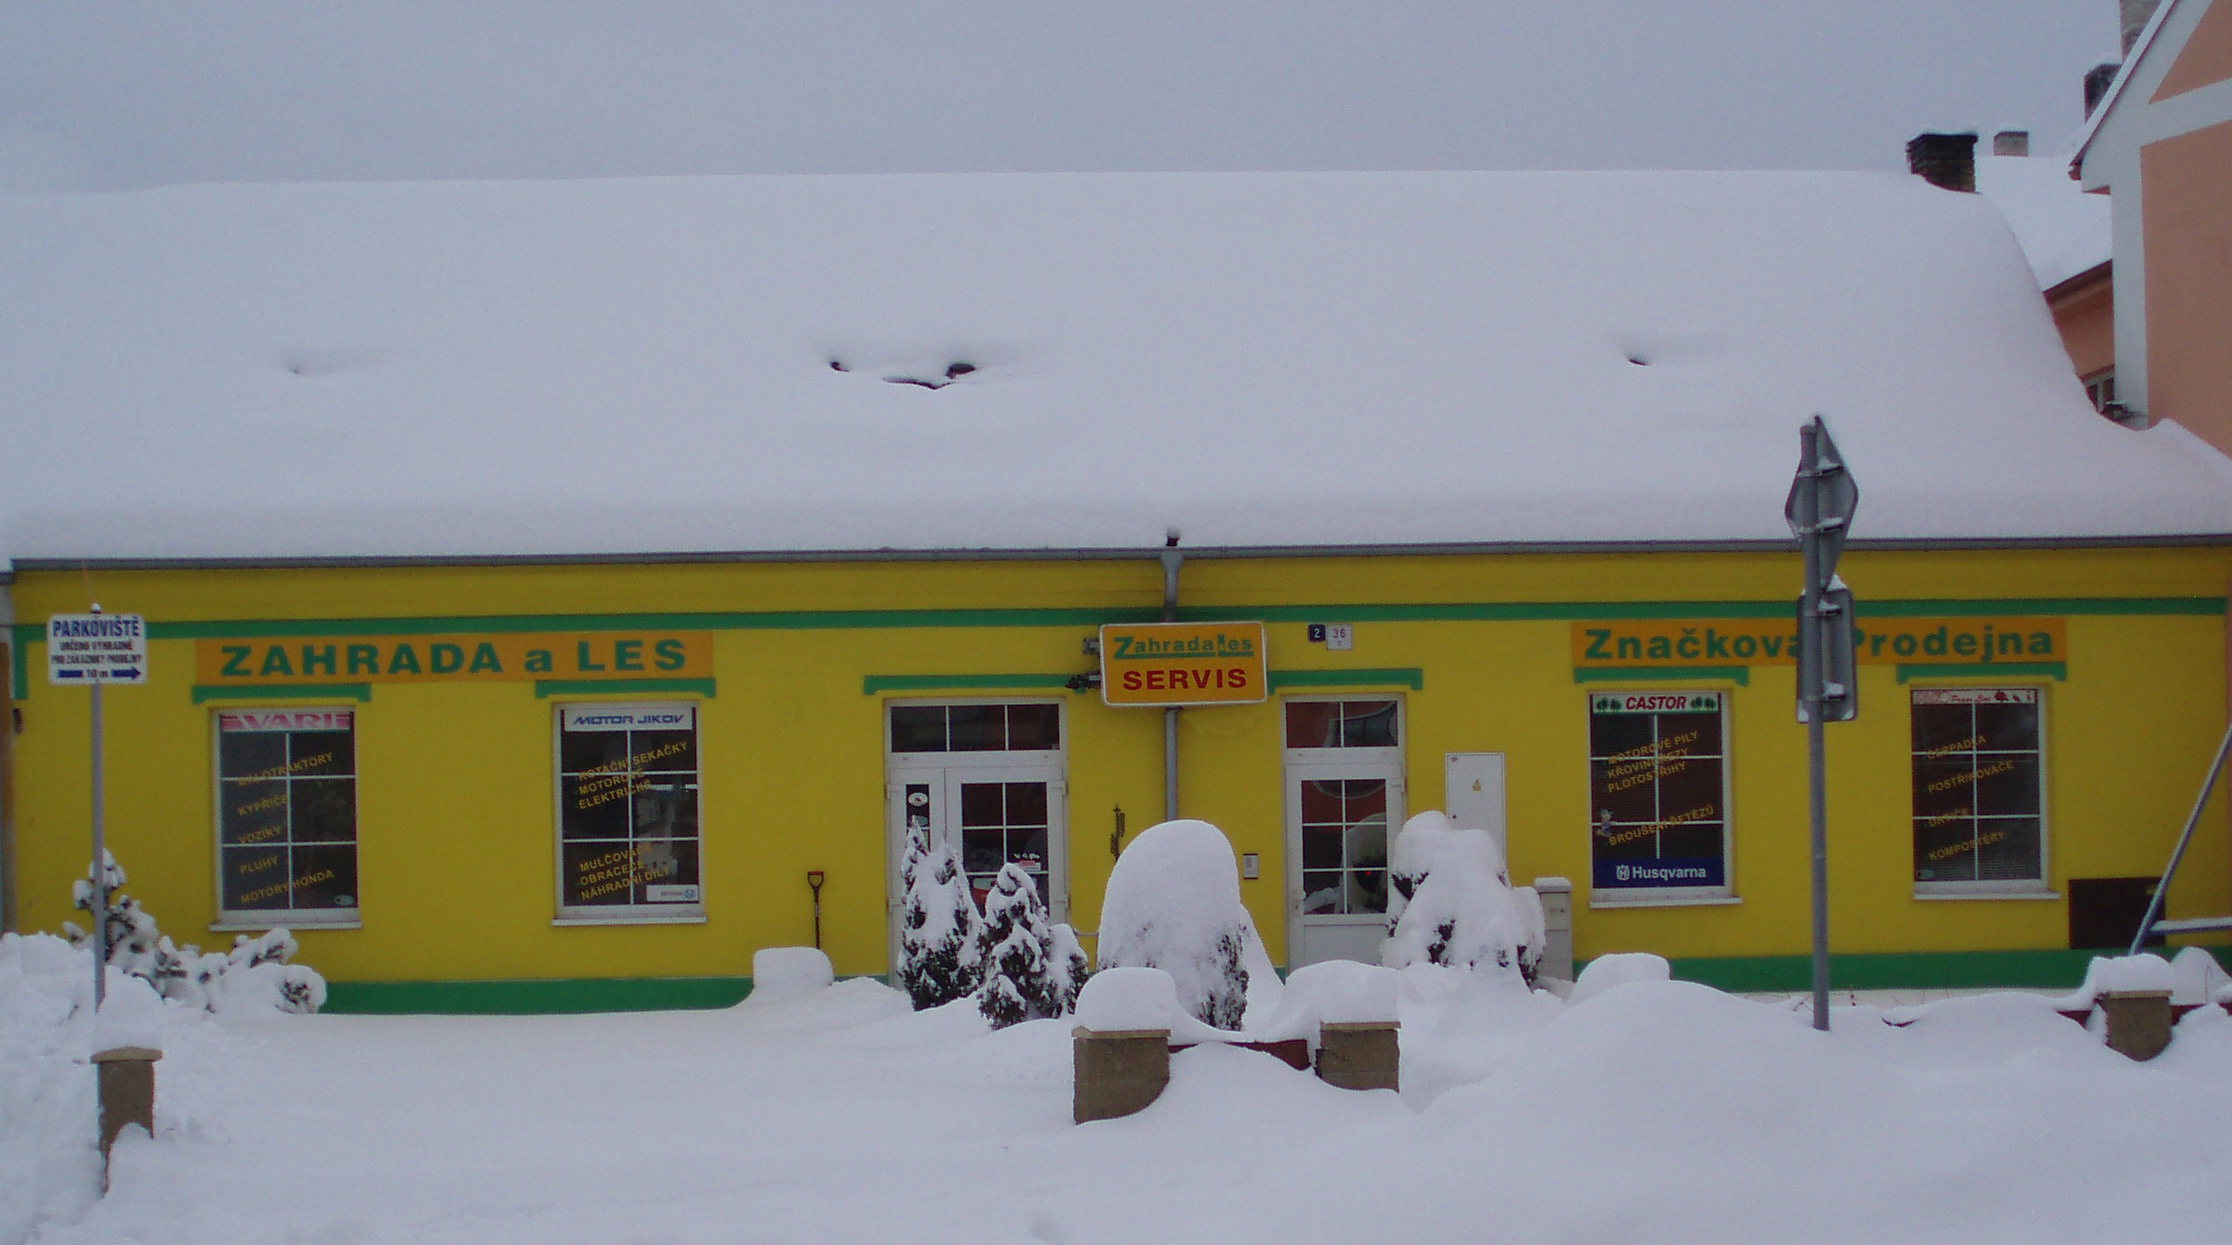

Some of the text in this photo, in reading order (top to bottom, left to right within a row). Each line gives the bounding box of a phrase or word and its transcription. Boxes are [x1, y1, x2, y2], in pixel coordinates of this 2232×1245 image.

[52, 615, 139, 637] PARKOVIŠTĚ
[1314, 628, 1320, 638] 2
[1333, 628, 1346, 639] 36
[221, 639, 686, 677] ZAHRADA a LES
[1123, 668, 1247, 690] SERVIS
[1625, 696, 1687, 710] CASTOR
[244, 713, 332, 729] VARI
[573, 714, 685, 726] MOTOR JIKOV
[1674, 731, 1699, 745] PILY
[633, 741, 688, 765] SEKAČKY
[240, 856, 278, 874] PLUHY
[1632, 866, 1707, 881] Husqvarna
[241, 869, 335, 904] MOTORY HONDA
